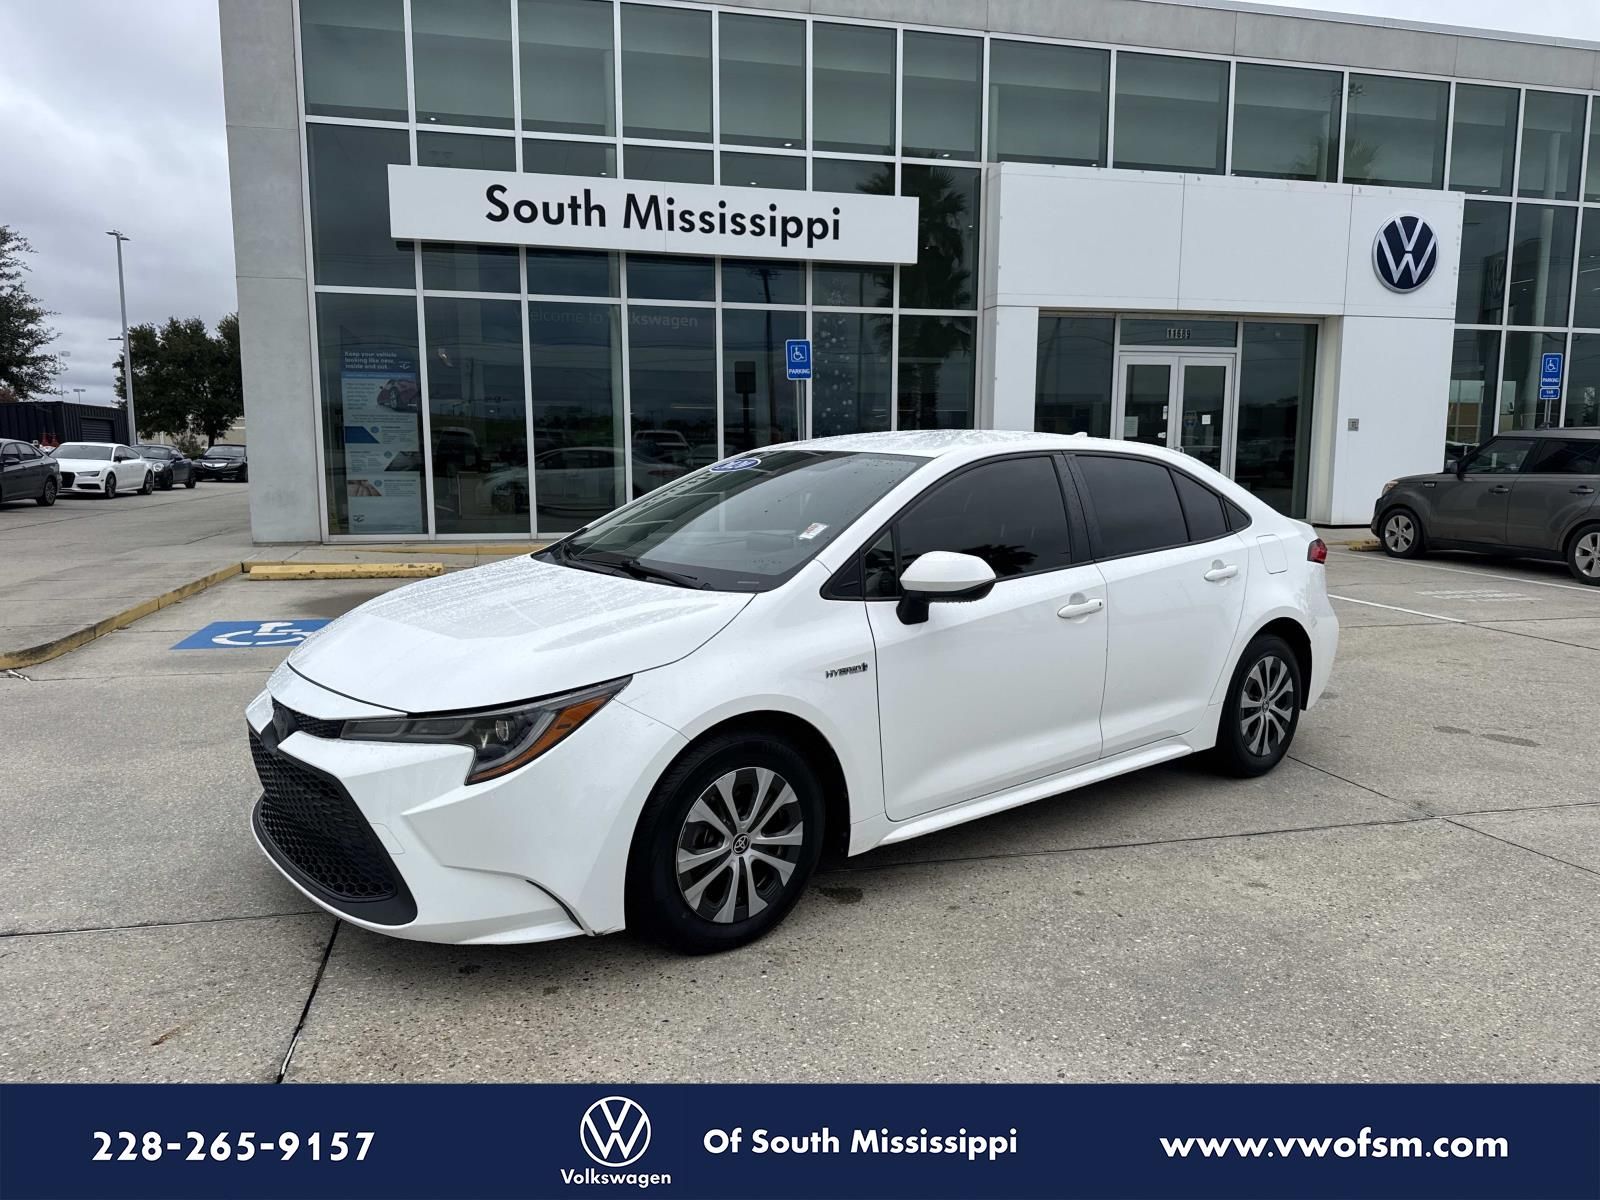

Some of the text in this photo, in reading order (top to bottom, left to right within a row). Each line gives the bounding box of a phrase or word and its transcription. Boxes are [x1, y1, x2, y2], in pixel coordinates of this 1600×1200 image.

[485, 183, 840, 249] South Mississippi
[1376, 213, 1438, 287] VW
[825, 663, 862, 679] HYBRID
